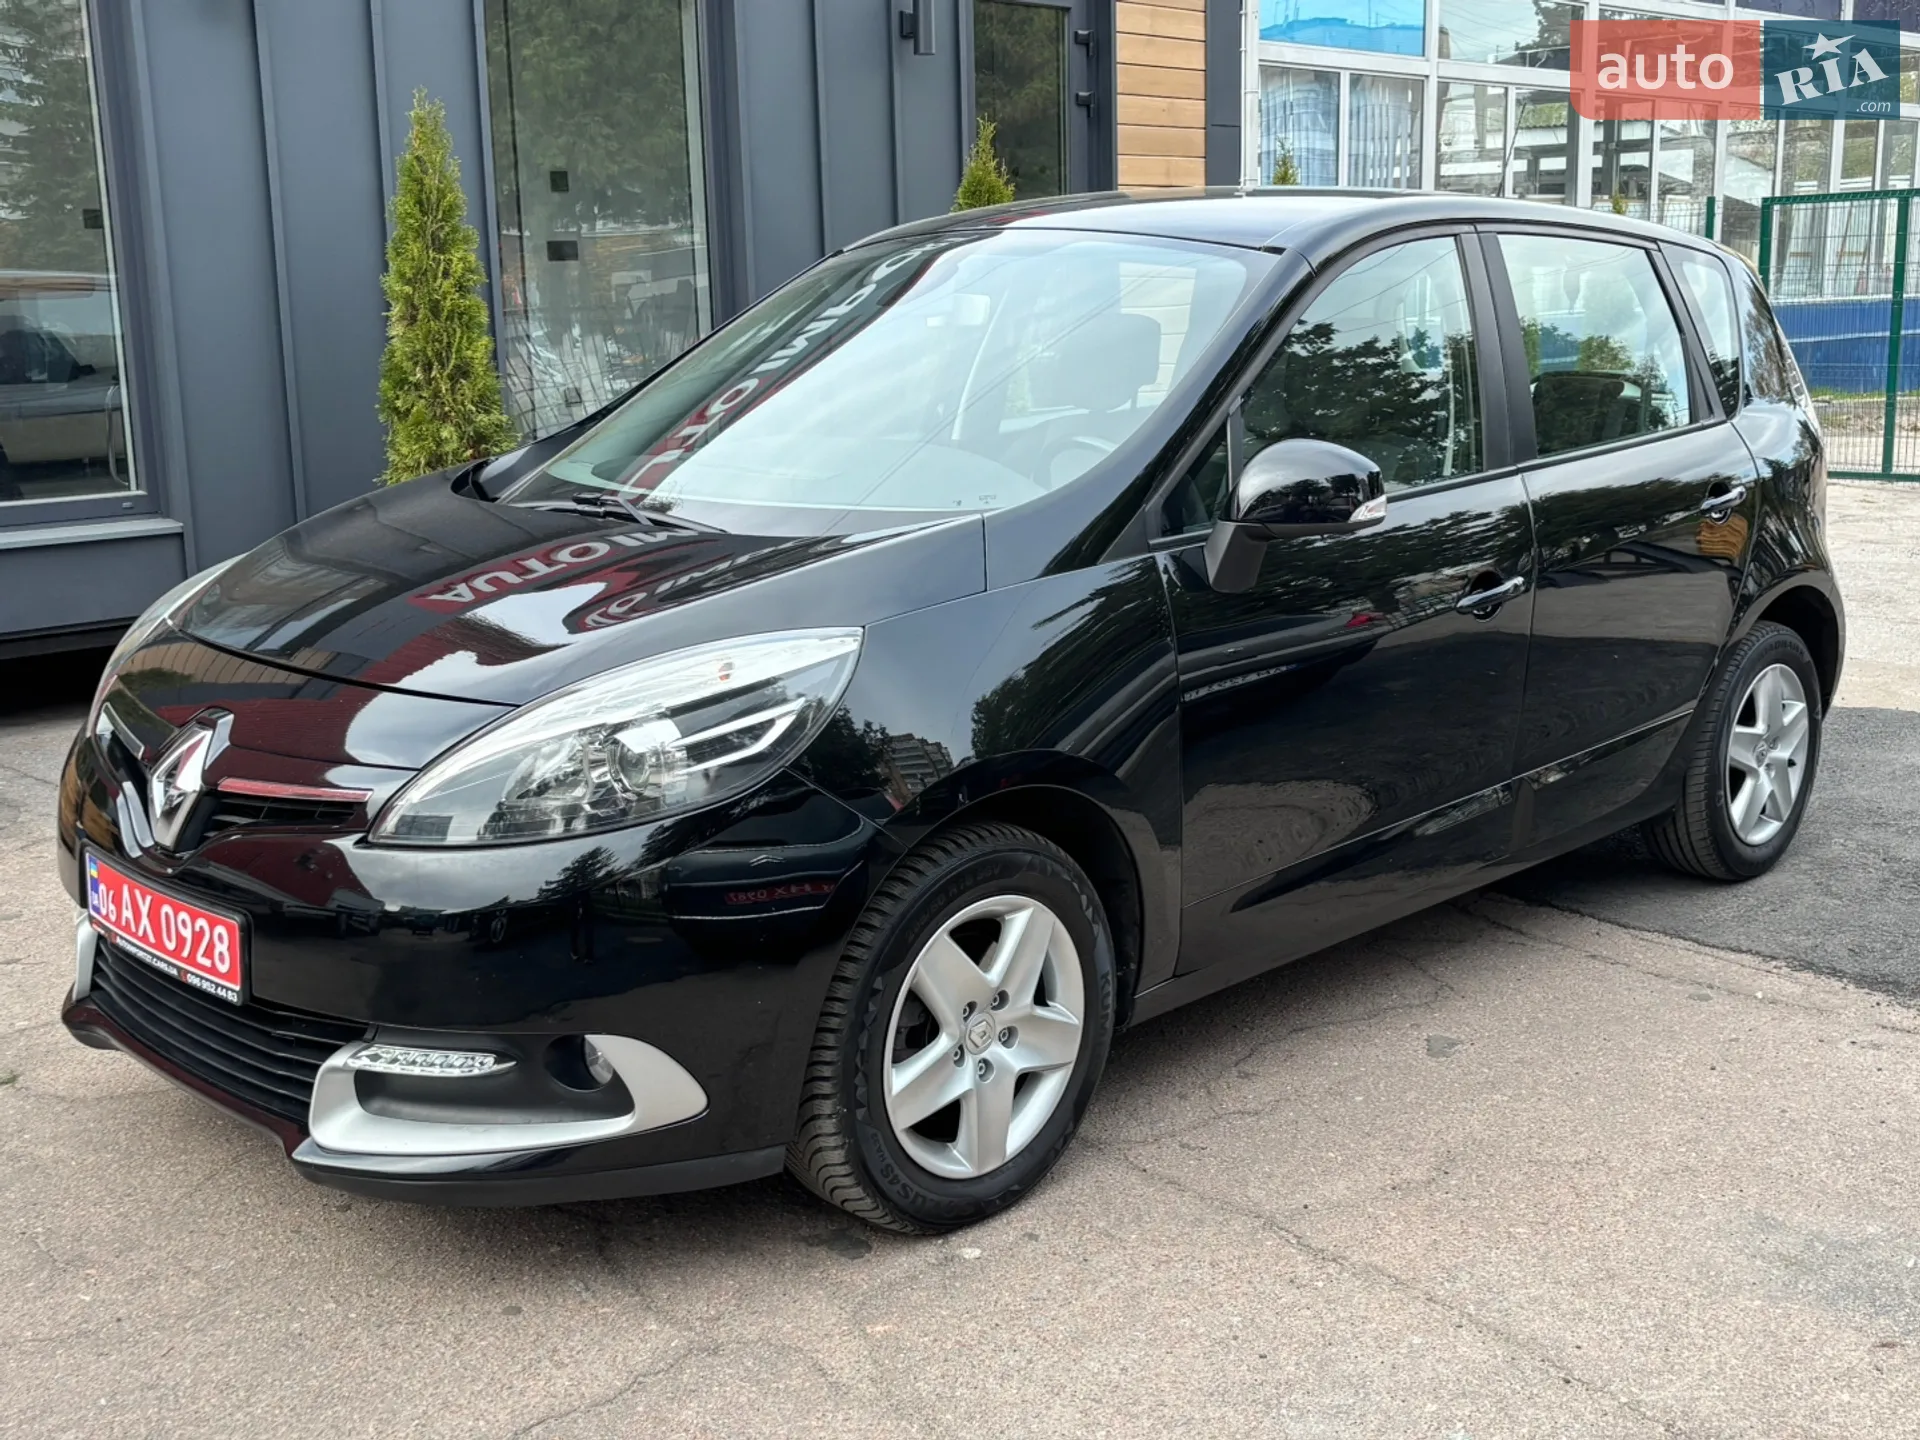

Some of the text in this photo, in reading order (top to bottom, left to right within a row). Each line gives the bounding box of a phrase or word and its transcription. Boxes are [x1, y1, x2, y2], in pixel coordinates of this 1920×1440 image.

[99, 883, 231, 974] 06 AX 0928
